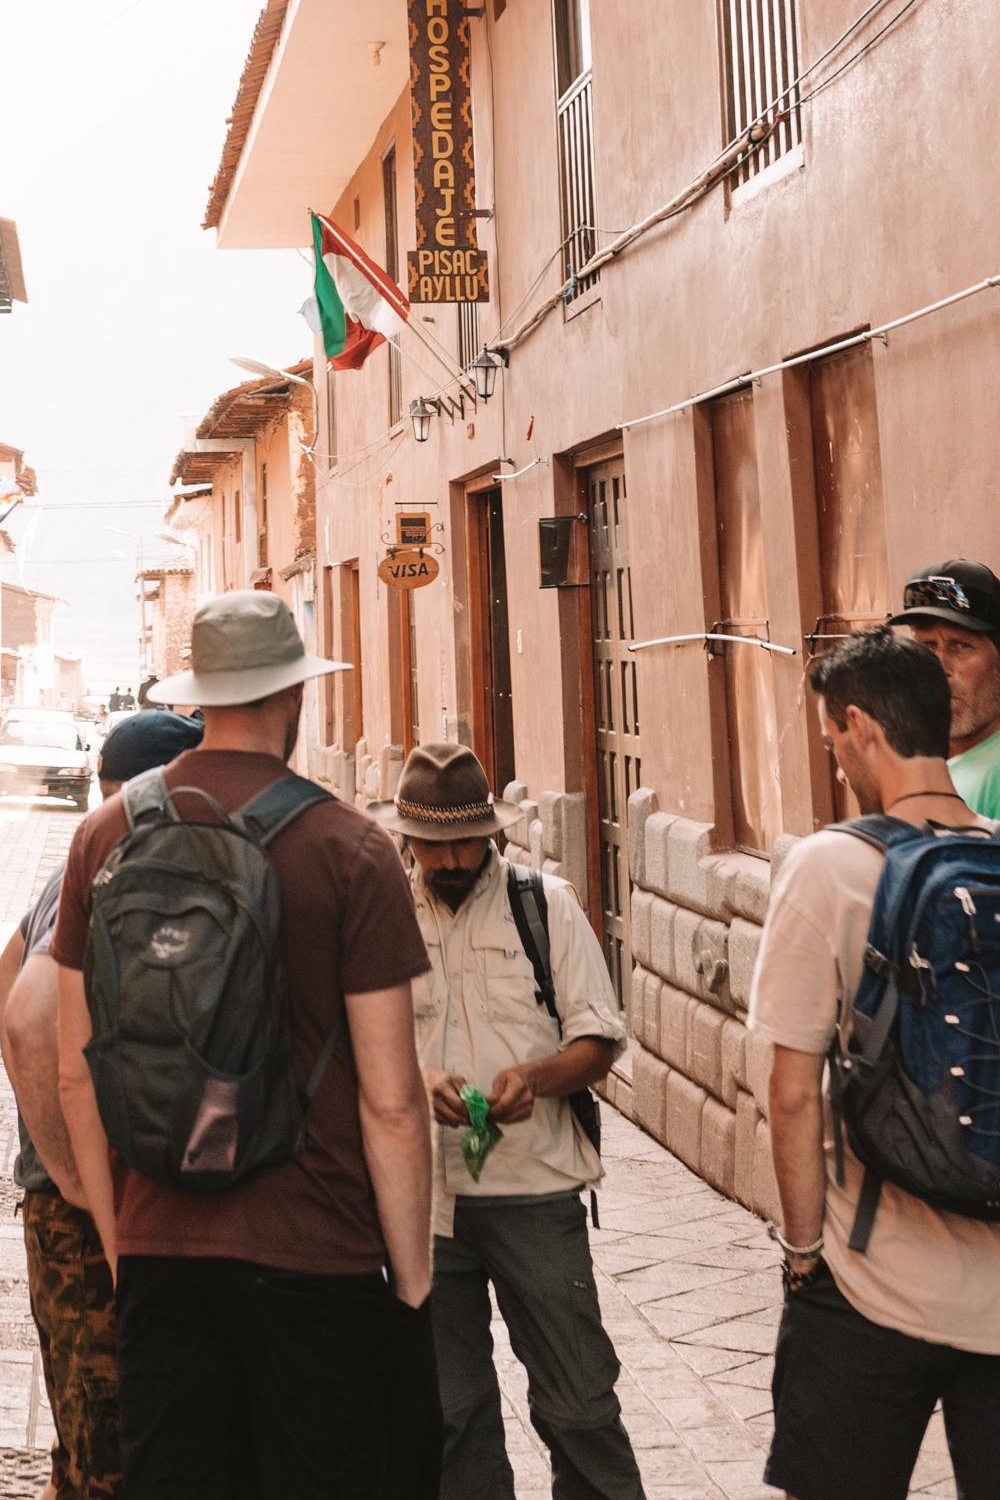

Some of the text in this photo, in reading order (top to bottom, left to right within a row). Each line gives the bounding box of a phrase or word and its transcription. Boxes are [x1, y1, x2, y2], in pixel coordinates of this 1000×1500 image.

[418, 250, 478, 275] PISAC
[420, 276, 479, 302] AYLLU
[387, 562, 429, 578] VISA
